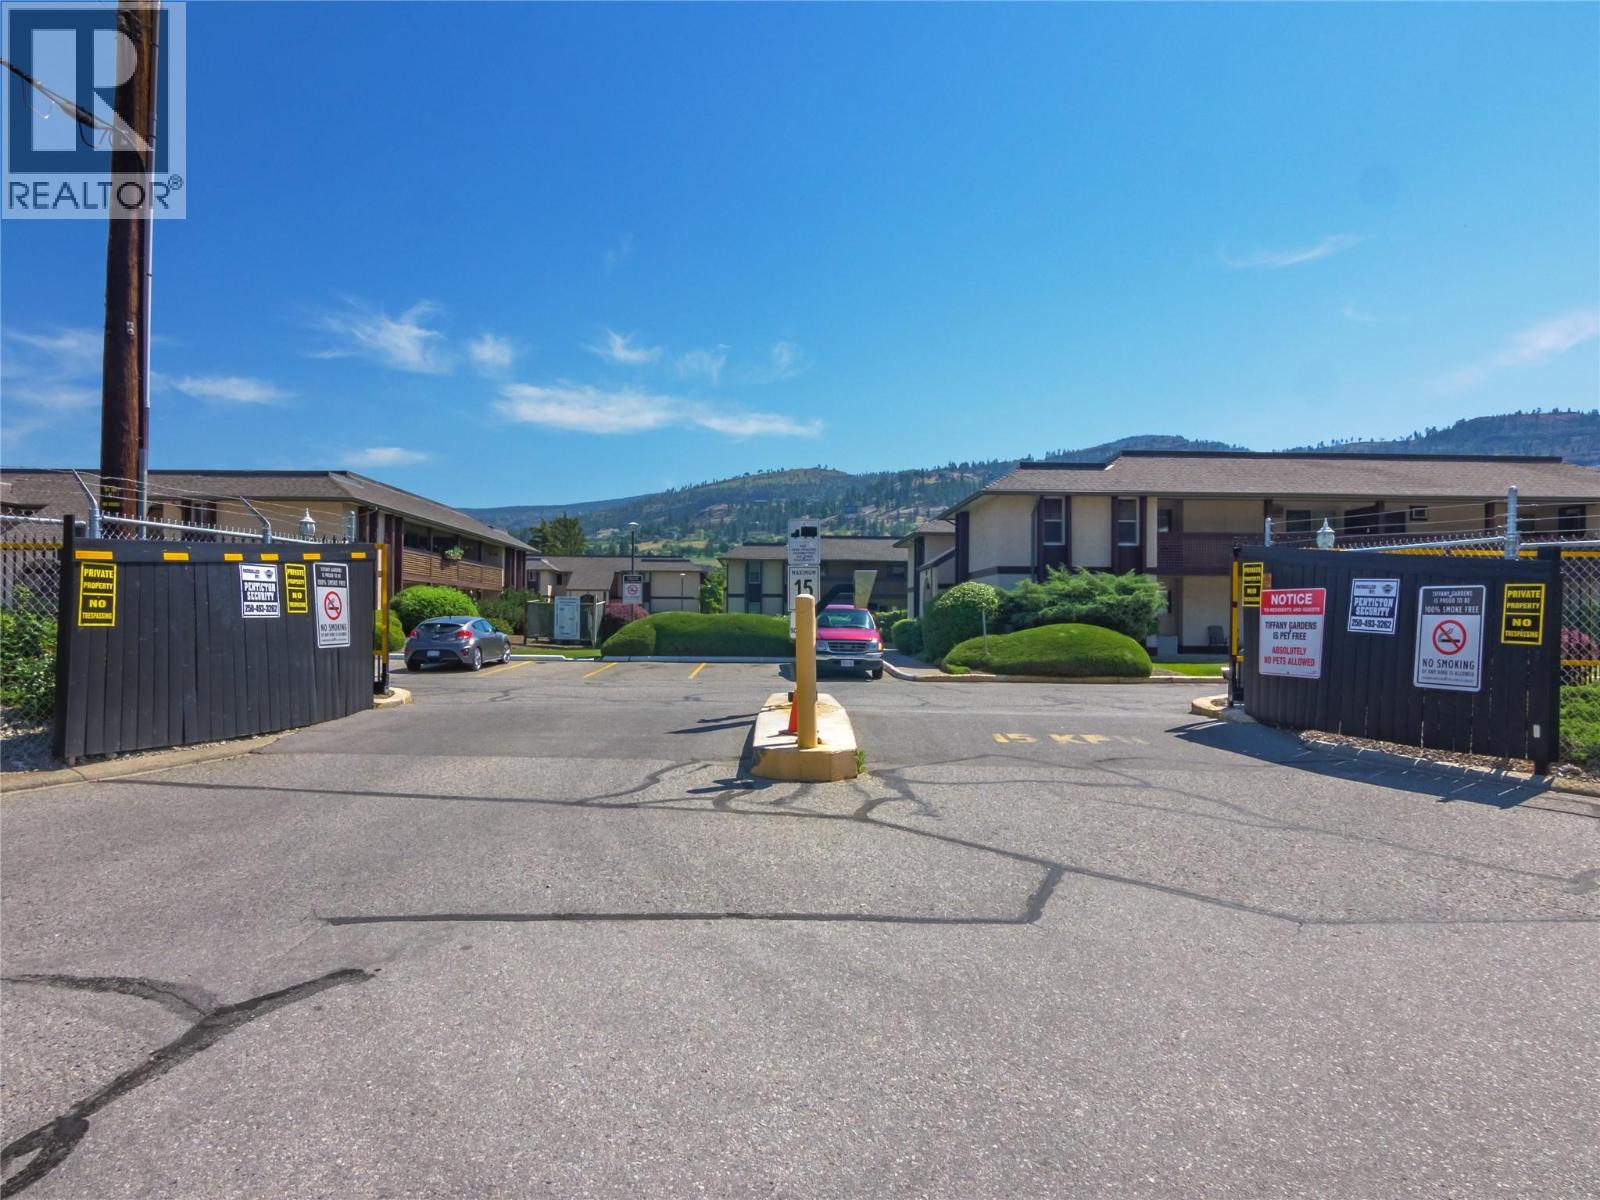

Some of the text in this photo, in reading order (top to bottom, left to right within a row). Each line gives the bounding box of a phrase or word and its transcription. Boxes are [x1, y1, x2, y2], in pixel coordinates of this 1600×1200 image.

[84, 568, 114, 578] PRIVATE
[83, 582, 113, 590] PROPERTY
[244, 582, 276, 592] PENTICTON
[794, 579, 814, 596] 15
[247, 592, 275, 601] SECURITY
[1507, 590, 1540, 598] PRIVATE
[89, 599, 107, 608] NO
[1271, 593, 1312, 606] NOTICE
[1354, 598, 1394, 608] PENTICTON
[1356, 606, 1390, 616] SECURITY
[1265, 622, 1317, 630] TIFFANY GARDENS
[1351, 619, 1392, 628] 250-493-3262
[1512, 618, 1532, 626] NO
[1273, 632, 1306, 640] IS PET FREE
[1272, 646, 1306, 656] ABSOLUTELY
[1264, 656, 1315, 667] NO PETS ALLOWED
[1422, 658, 1475, 670] NO SMOKING
